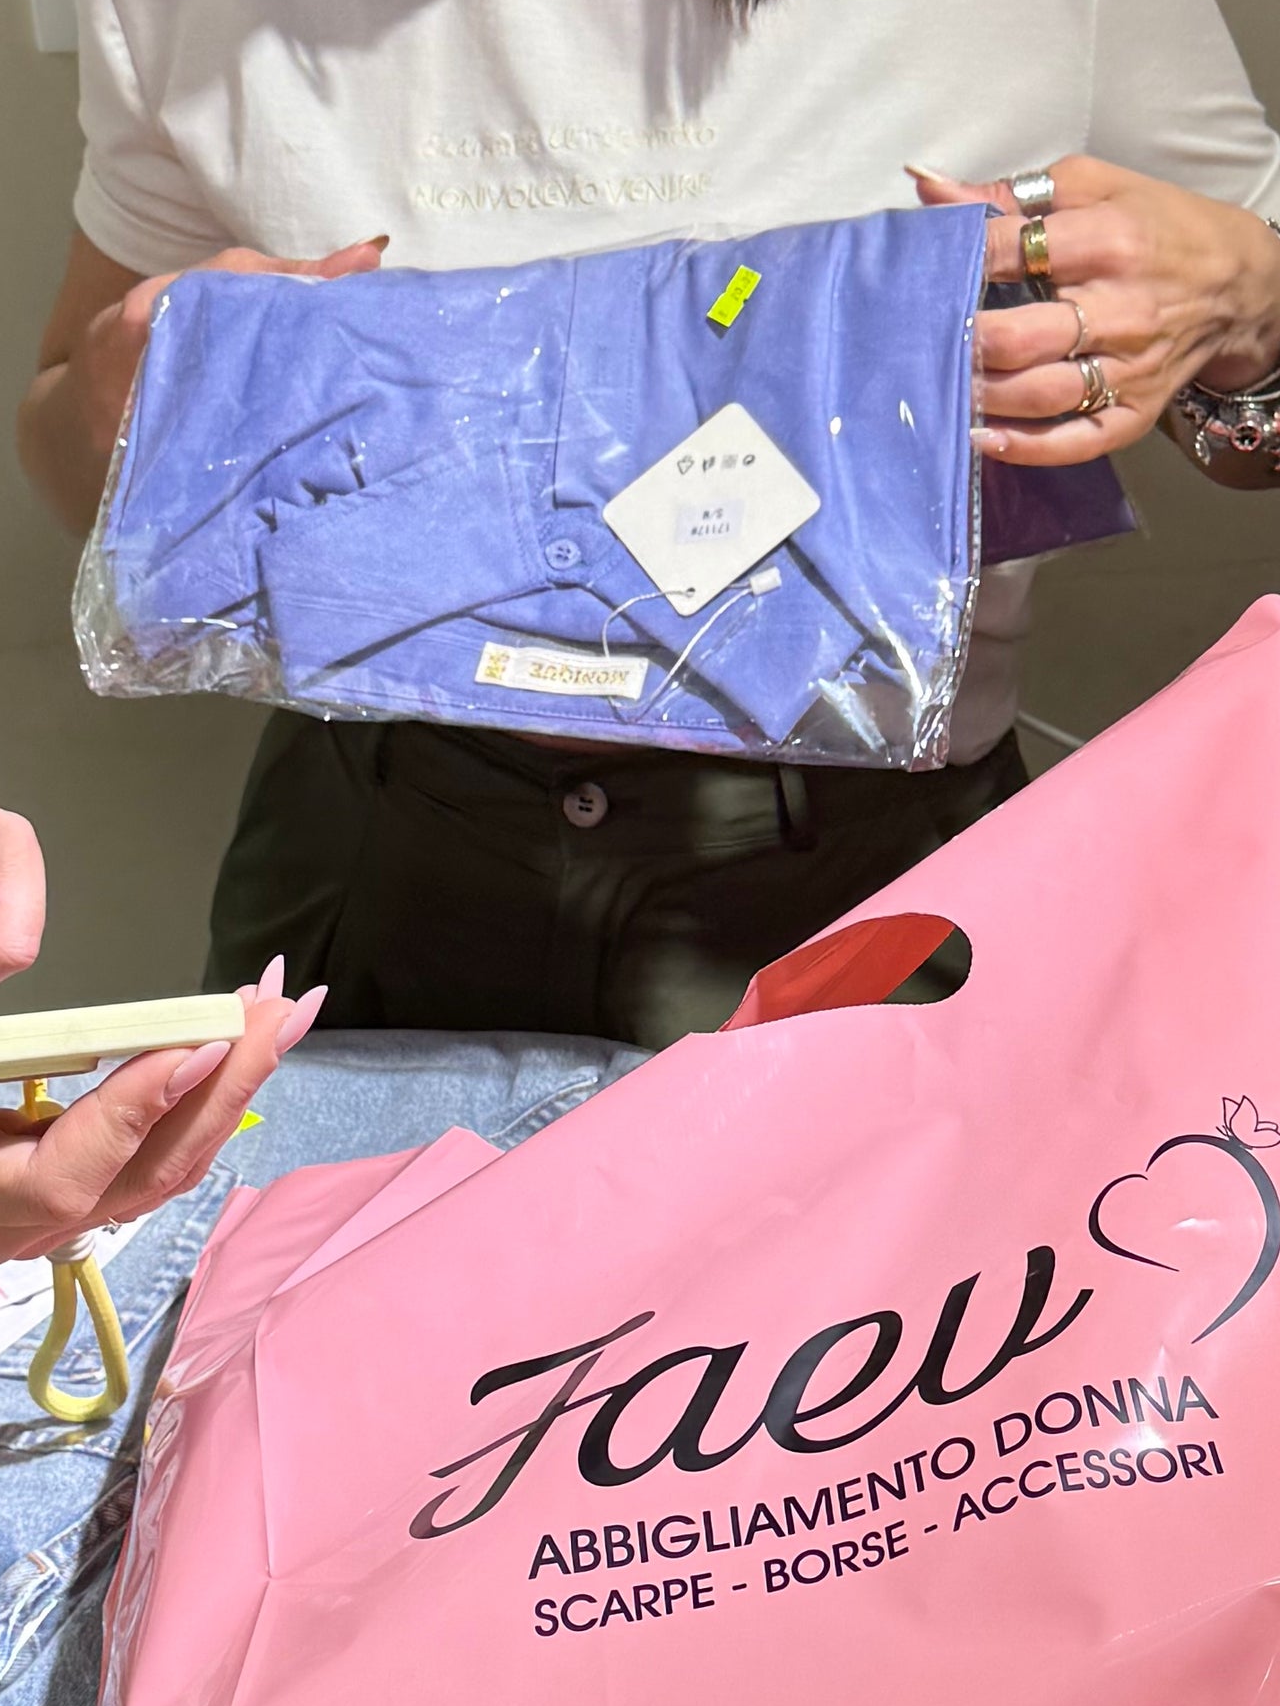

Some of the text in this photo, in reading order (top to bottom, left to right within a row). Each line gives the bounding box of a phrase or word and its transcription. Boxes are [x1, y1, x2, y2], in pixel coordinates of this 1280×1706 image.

[409, 1246, 1094, 1547] Faev
[528, 1374, 1219, 1584] ABBIGLIAMENTO DONNA
[535, 1573, 715, 1636] SCARPE
[765, 1527, 910, 1594] BORSE
[953, 1441, 1224, 1532] ACCESSORI
